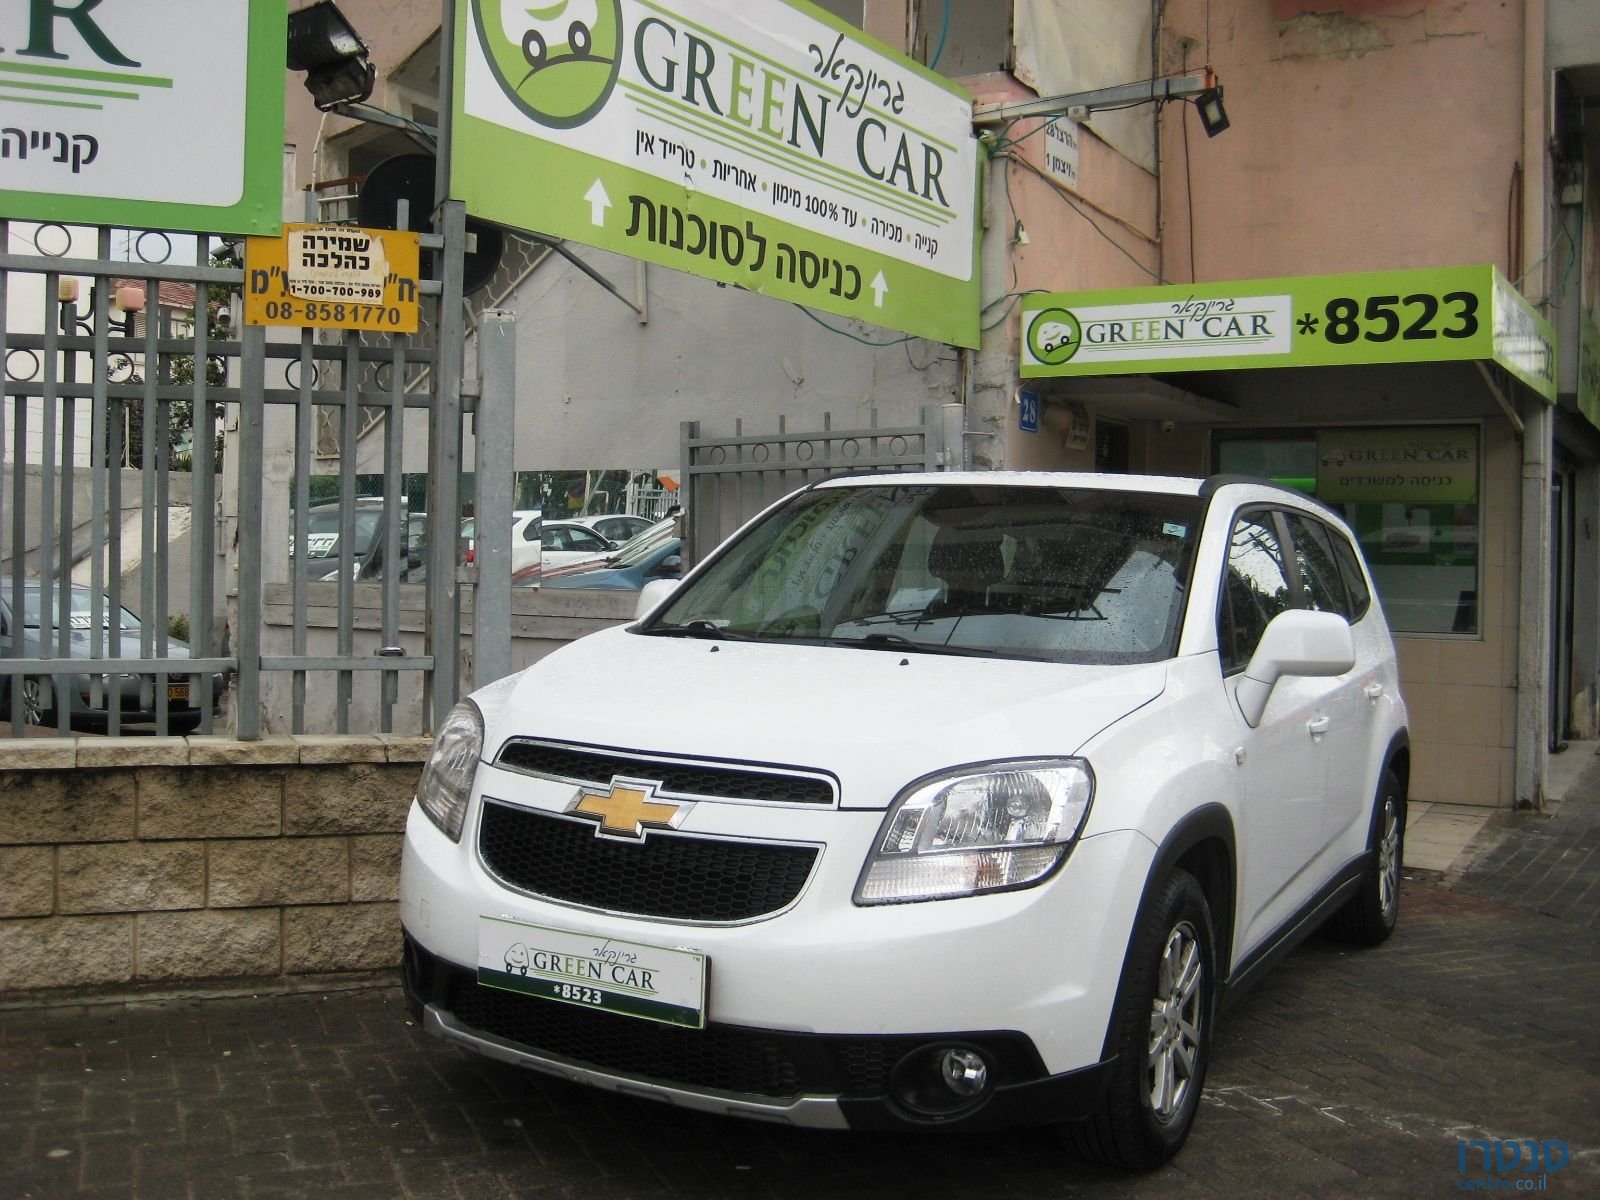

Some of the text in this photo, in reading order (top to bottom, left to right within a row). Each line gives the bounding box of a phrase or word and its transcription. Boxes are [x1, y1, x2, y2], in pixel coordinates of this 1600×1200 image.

[809, 32, 904, 118] גרינקאר
[633, 17, 950, 208] GREEN CAR
[1, 127, 99, 174] קנייה
[636, 128, 938, 259] קנייה מכירה עד 100% מימון אחריות טרייד אין
[302, 235, 371, 252] שמירה
[625, 195, 862, 300] כניסה לסוכנות
[302, 252, 370, 271] כהלכה
[290, 285, 381, 298] 1-700-700-989
[265, 301, 401, 325] 08-8581770
[1171, 295, 1235, 322] גרינקאר
[1085, 314, 1272, 343] GREEN CAR
[1022, 399, 1036, 423] 28
[1350, 449, 1470, 462] GREEN CAR
[1410, 475, 1452, 487] כניסה
[592, 939, 637, 966] גרינקאר
[533, 952, 655, 990] GREEN CAR
